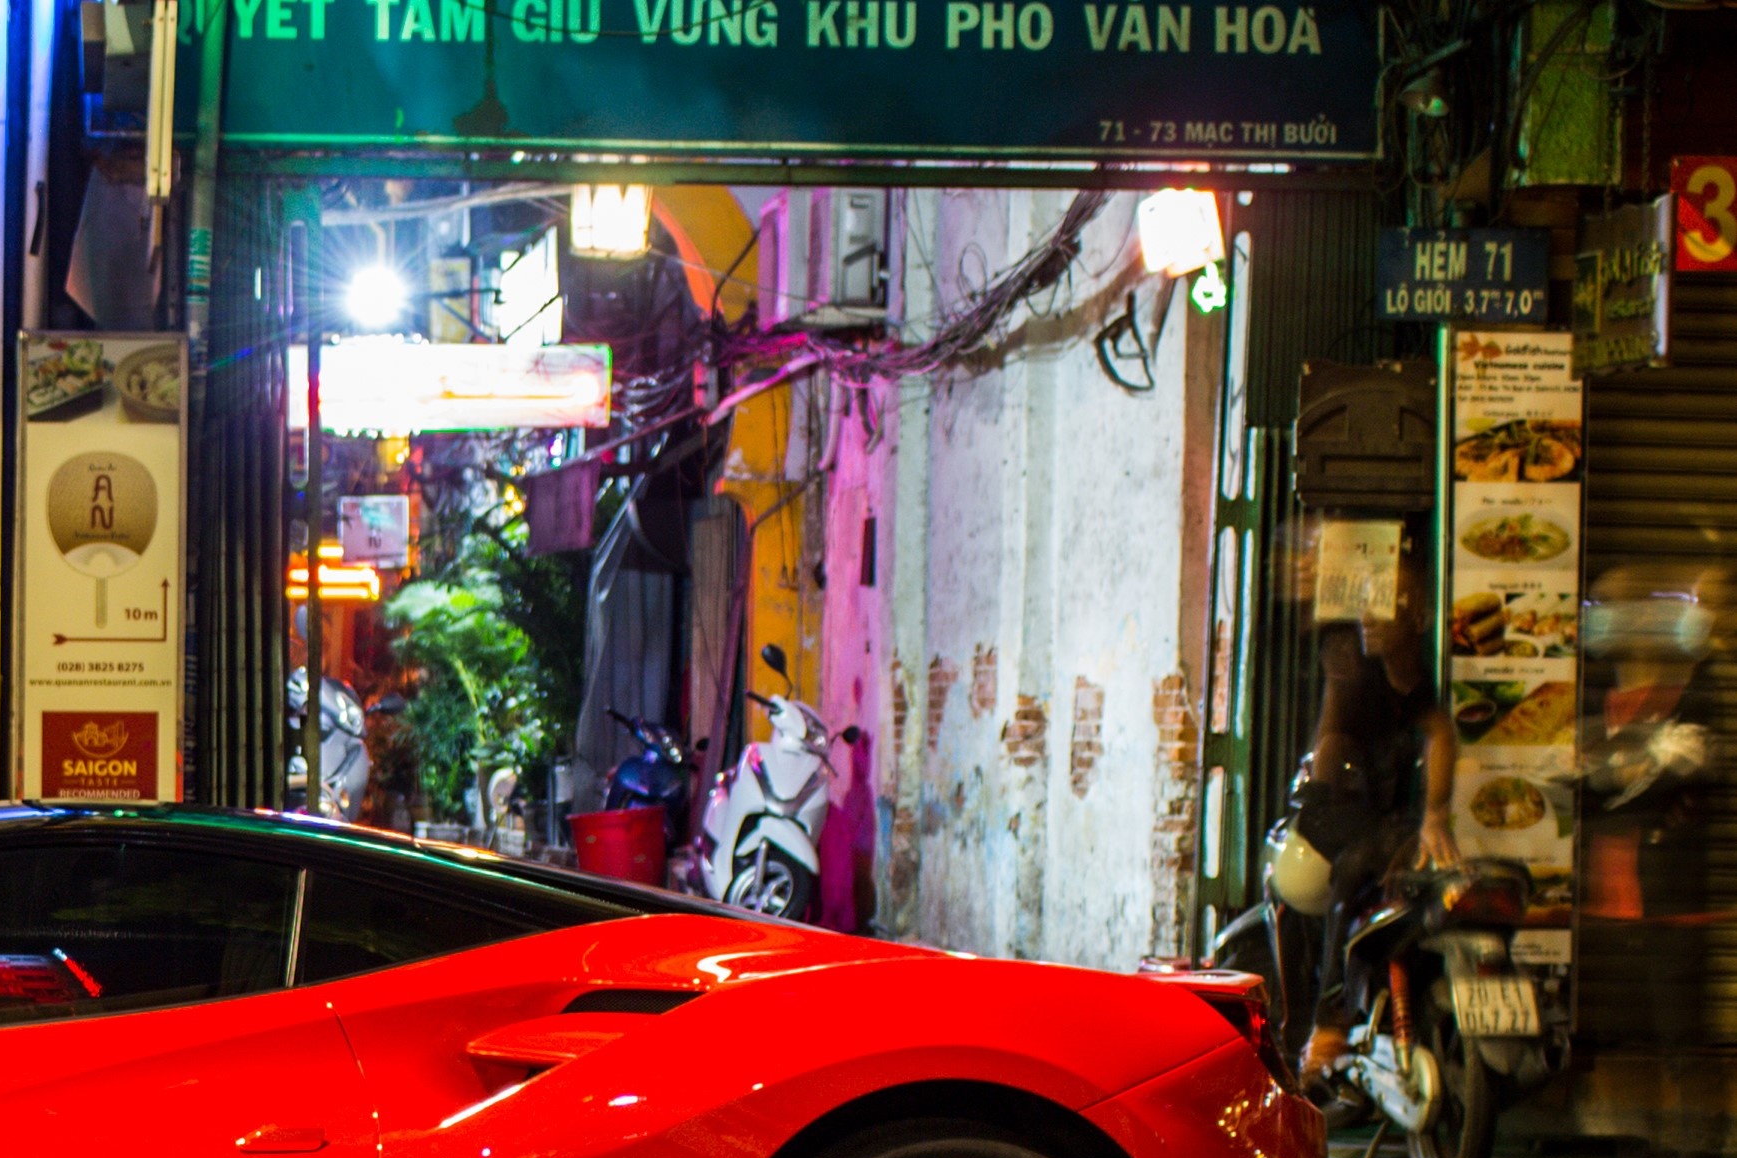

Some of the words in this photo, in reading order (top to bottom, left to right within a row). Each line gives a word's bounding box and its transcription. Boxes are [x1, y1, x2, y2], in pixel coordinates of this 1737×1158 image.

[806, 0, 918, 48] KHU
[1099, 119, 1126, 142] 71
[1150, 121, 1177, 142] 73
[1185, 121, 1234, 148] MẠC
[1241, 121, 1277, 148] THỊ
[1684, 165, 1736, 263] 3
[1415, 231, 1468, 281] HẺM
[1485, 241, 1513, 281] 71
[57, 661, 85, 673] (028)
[88, 661, 114, 672] 3825
[117, 661, 144, 672] 8275
[63, 760, 137, 776] SAIGON
[81, 778, 118, 786] TASTE
[59, 789, 141, 799] RECOMMENDED
